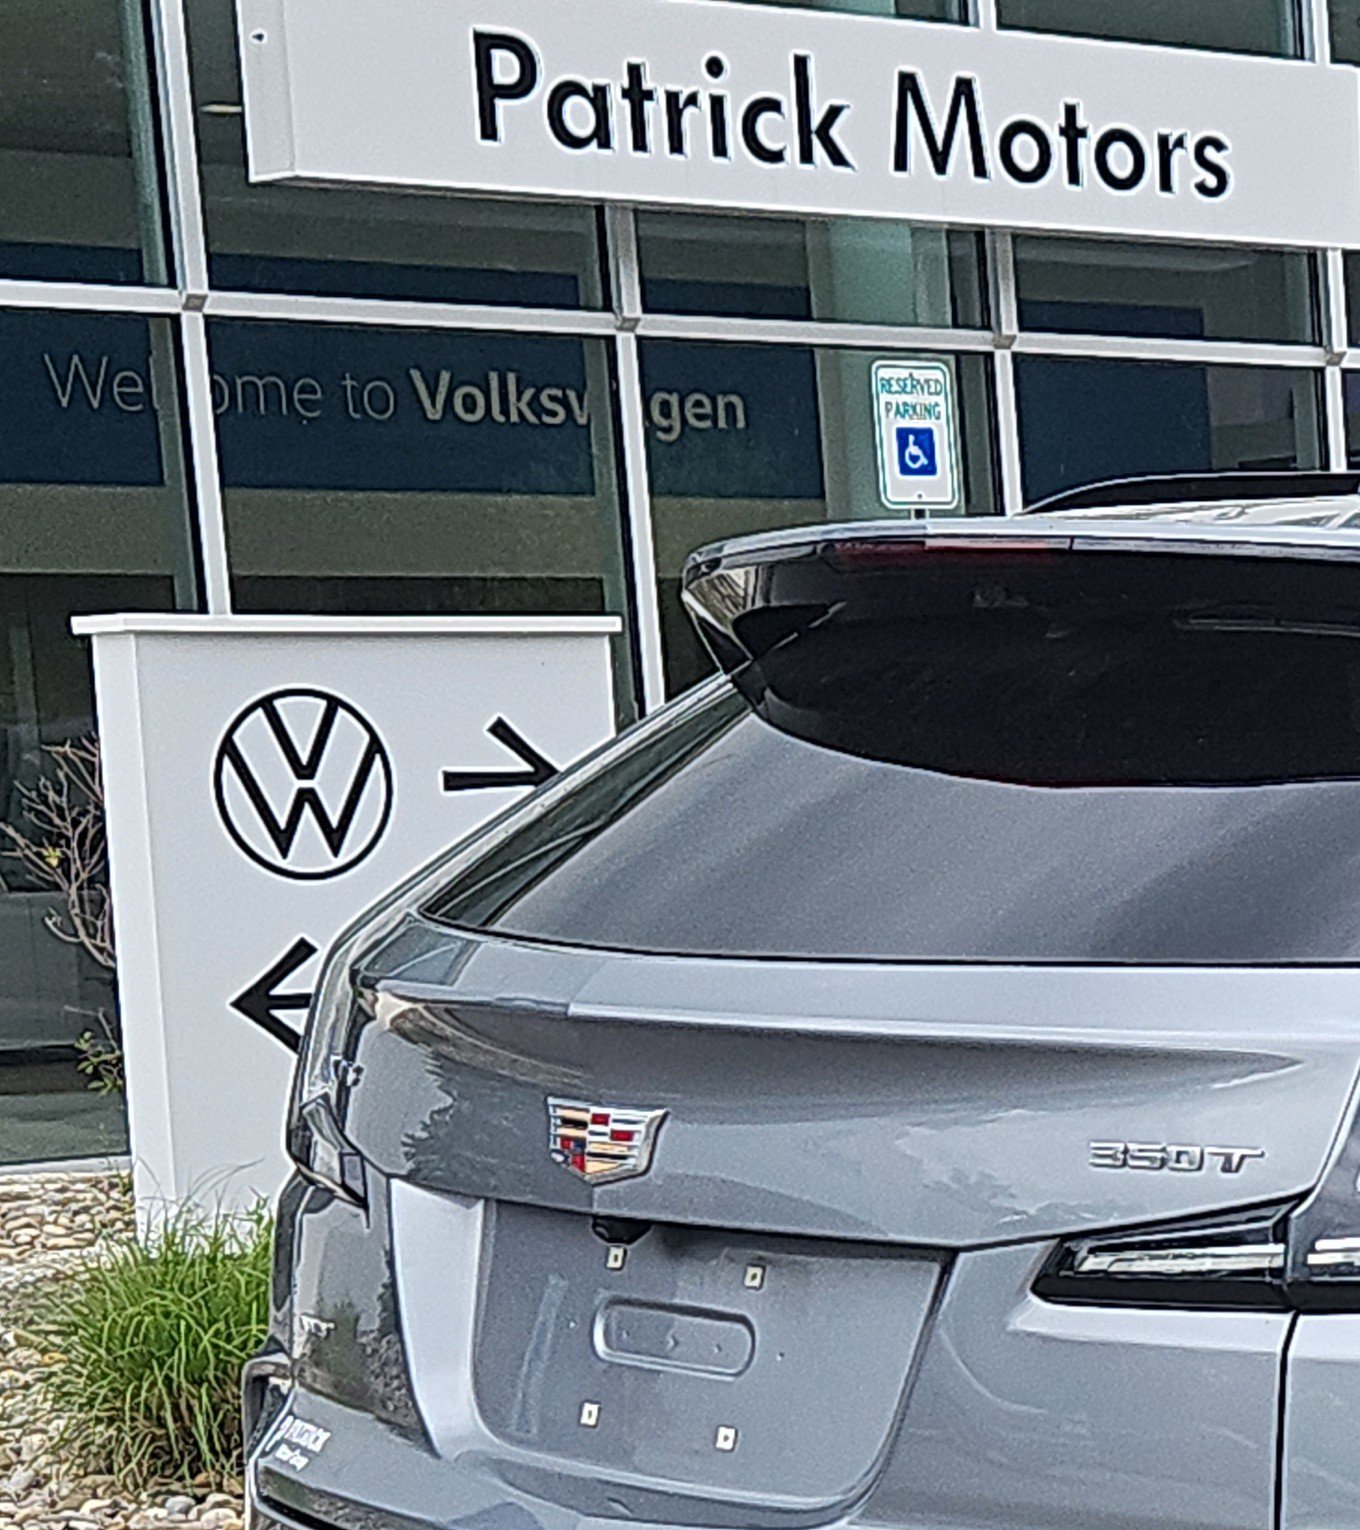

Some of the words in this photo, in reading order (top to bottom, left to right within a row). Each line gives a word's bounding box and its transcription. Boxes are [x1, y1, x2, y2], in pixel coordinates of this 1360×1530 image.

[472, 28, 854, 170] Patrick
[892, 69, 1231, 198] Motors
[44, 354, 322, 417] Welome
[342, 372, 395, 419] to
[409, 368, 746, 442] Volksgen
[880, 376, 943, 396] RESERVED
[885, 401, 941, 420] PARKING
[1088, 1139, 1266, 1174] 350T
